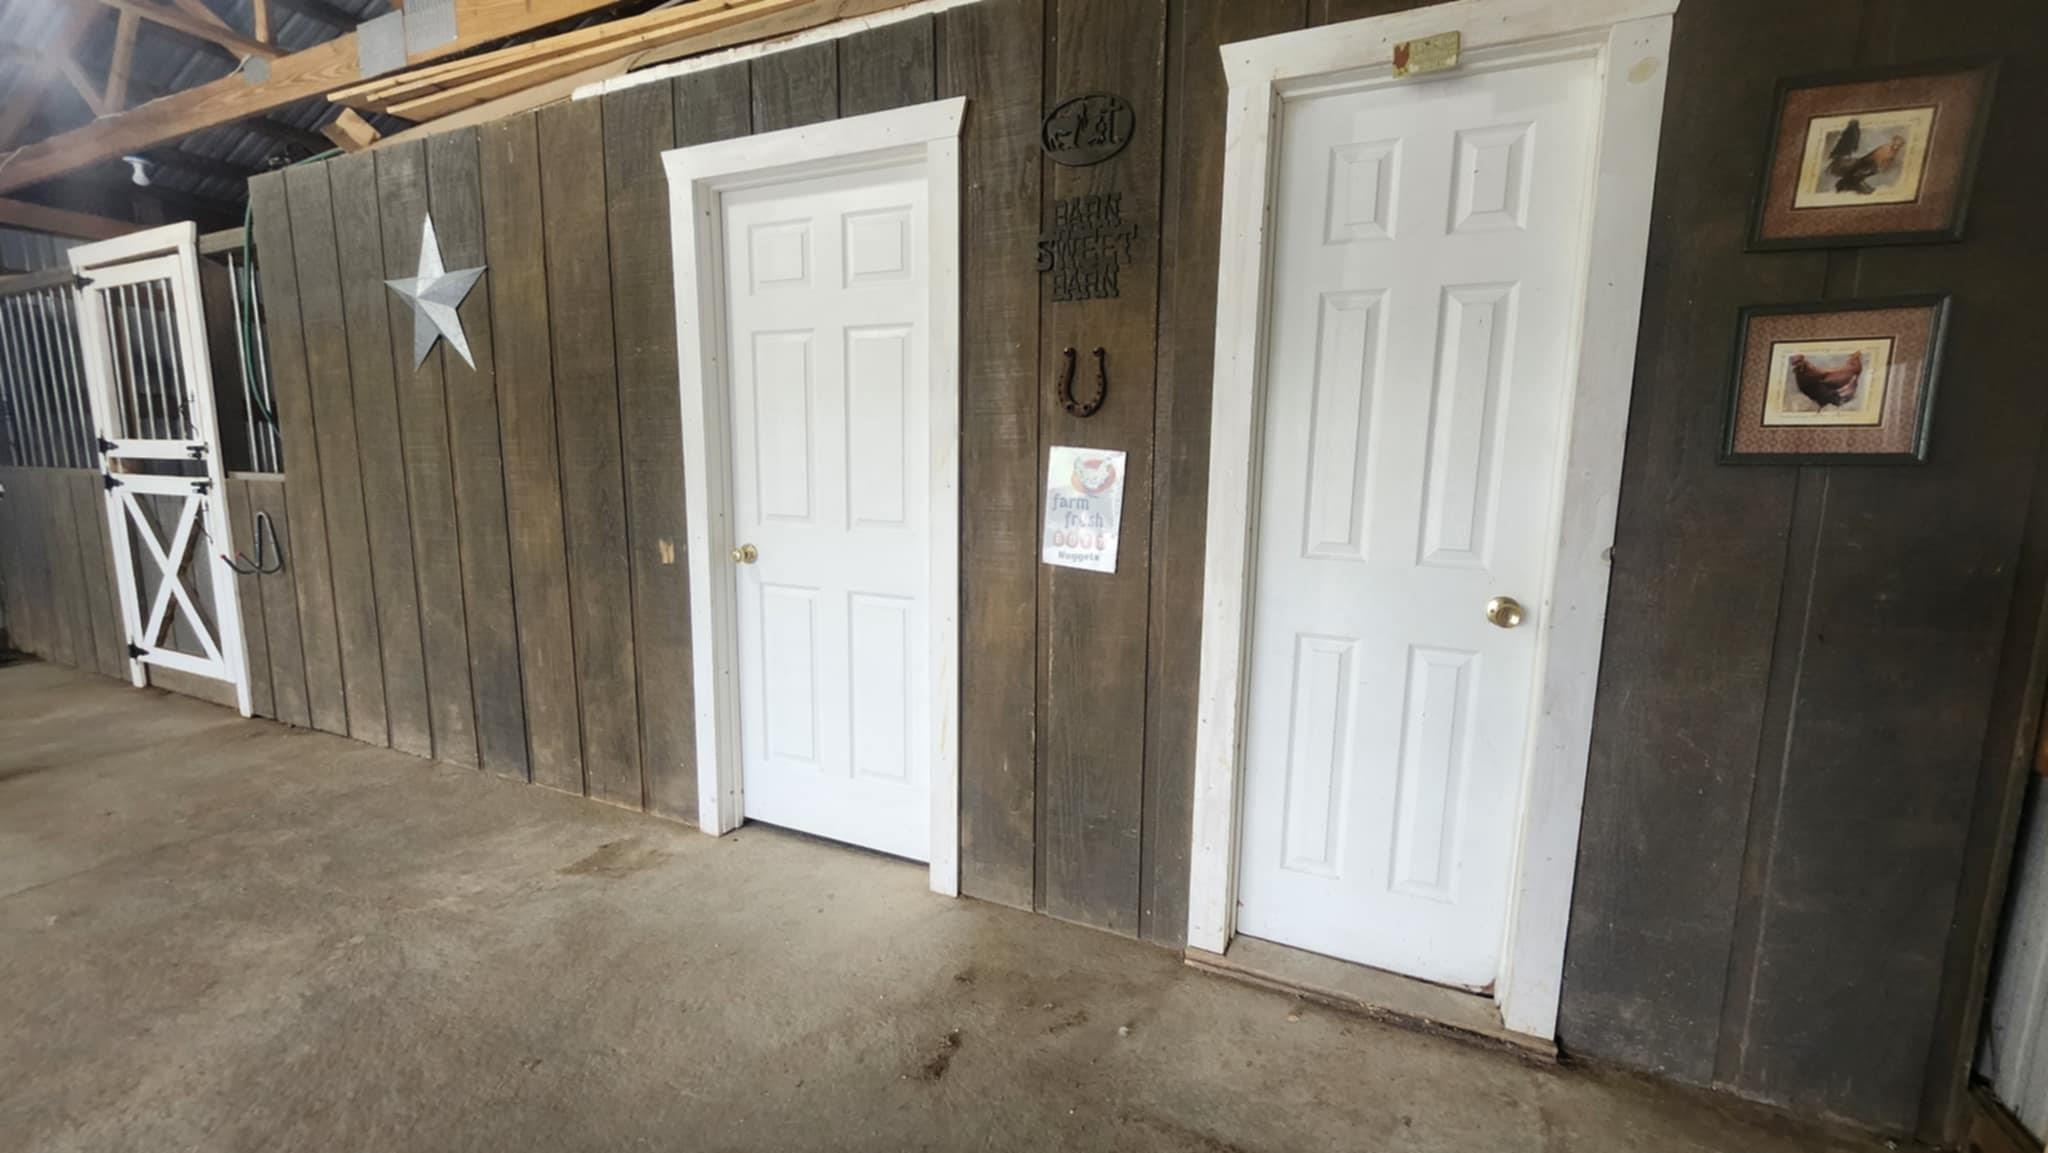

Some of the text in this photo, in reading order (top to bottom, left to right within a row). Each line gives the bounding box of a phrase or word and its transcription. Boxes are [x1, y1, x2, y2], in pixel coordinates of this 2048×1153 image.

[1055, 191, 1122, 230] BARN
[1037, 224, 1138, 273] SWEET
[1052, 264, 1120, 301] BARN
[1051, 492, 1089, 511] farm
